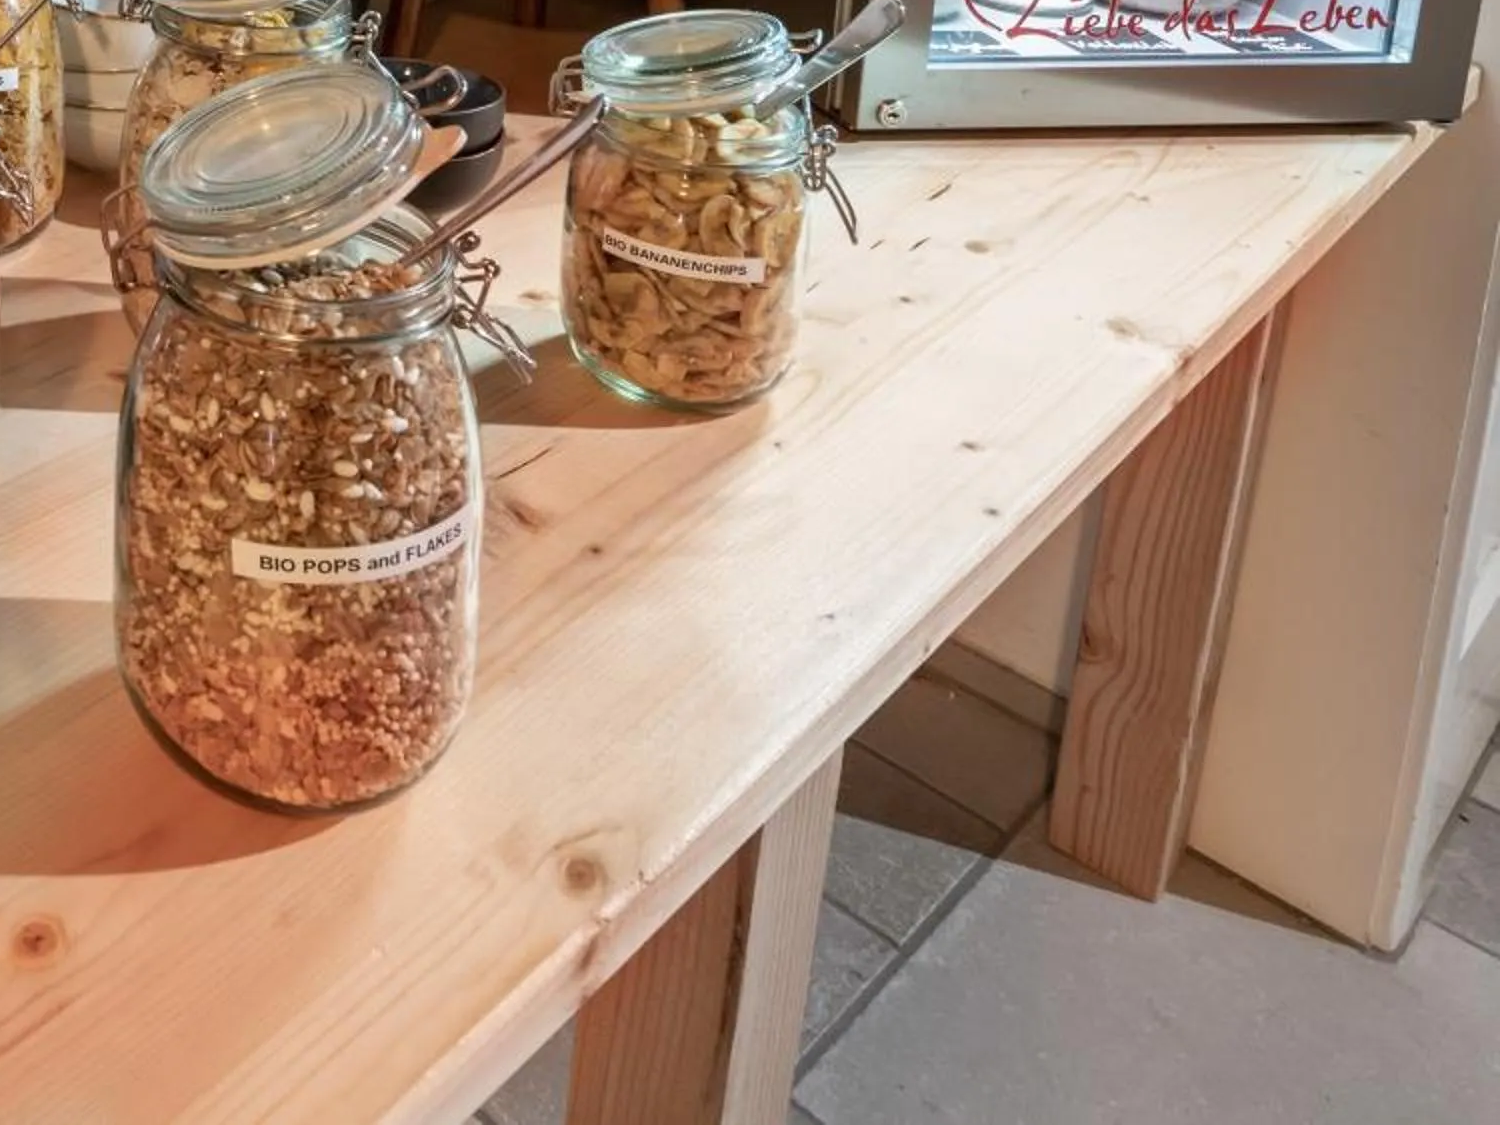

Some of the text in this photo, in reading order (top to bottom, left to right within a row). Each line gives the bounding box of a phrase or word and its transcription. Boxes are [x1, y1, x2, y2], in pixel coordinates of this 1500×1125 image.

[605, 233, 749, 277] BIO BANANENCHIPS
[259, 522, 463, 575] BIO POPS and FLAKES
